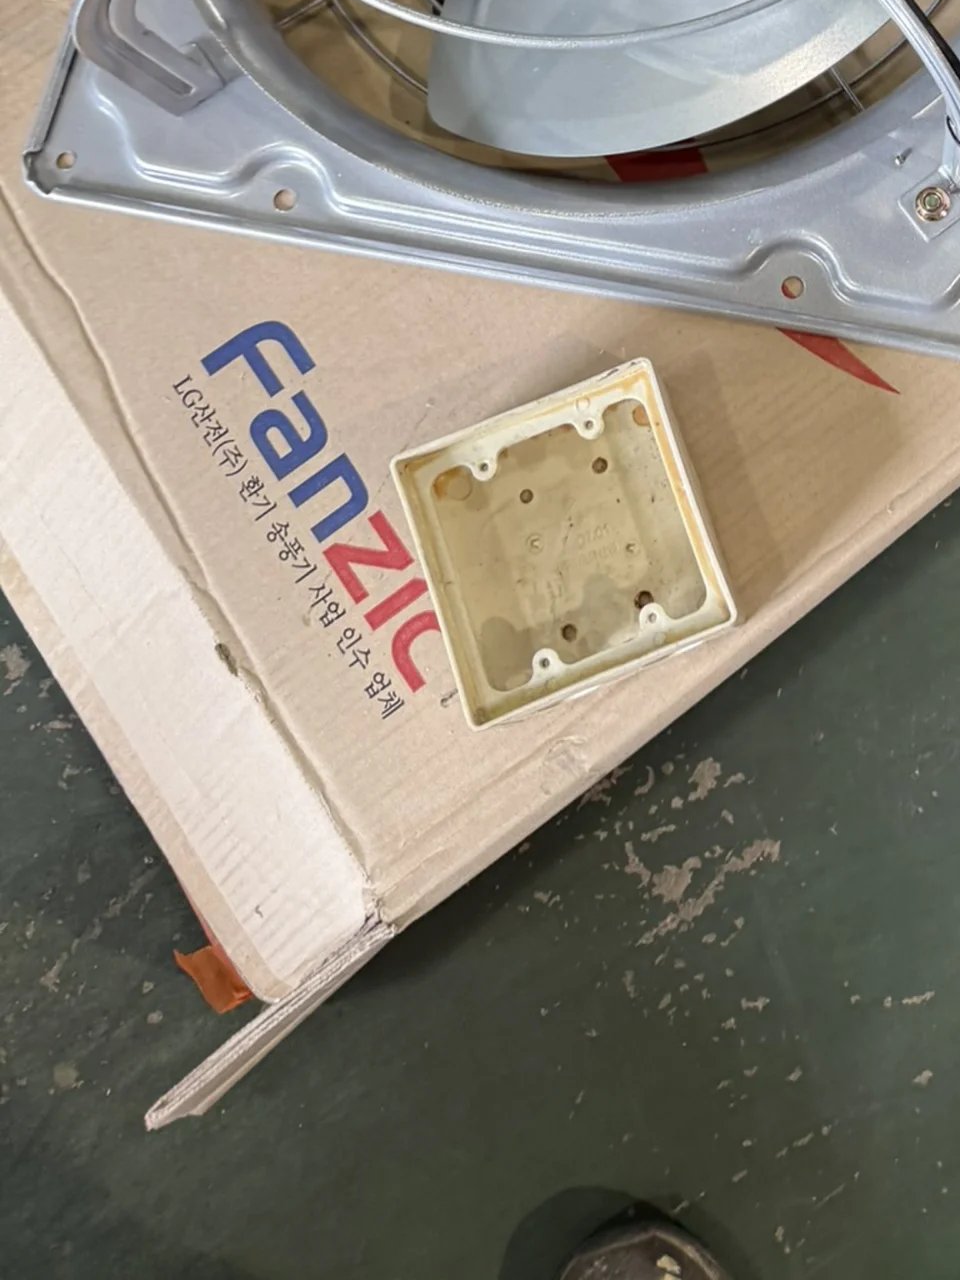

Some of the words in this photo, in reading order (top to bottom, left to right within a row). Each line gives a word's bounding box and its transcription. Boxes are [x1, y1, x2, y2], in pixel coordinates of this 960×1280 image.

[172, 374, 249, 479] LG산전(주)
[238, 474, 278, 523] 환기
[266, 520, 318, 585] 송풍기
[308, 583, 347, 629] 사업
[335, 626, 371, 670] 인수
[363, 671, 406, 720] 업체
[201, 320, 443, 693] Fanzic
